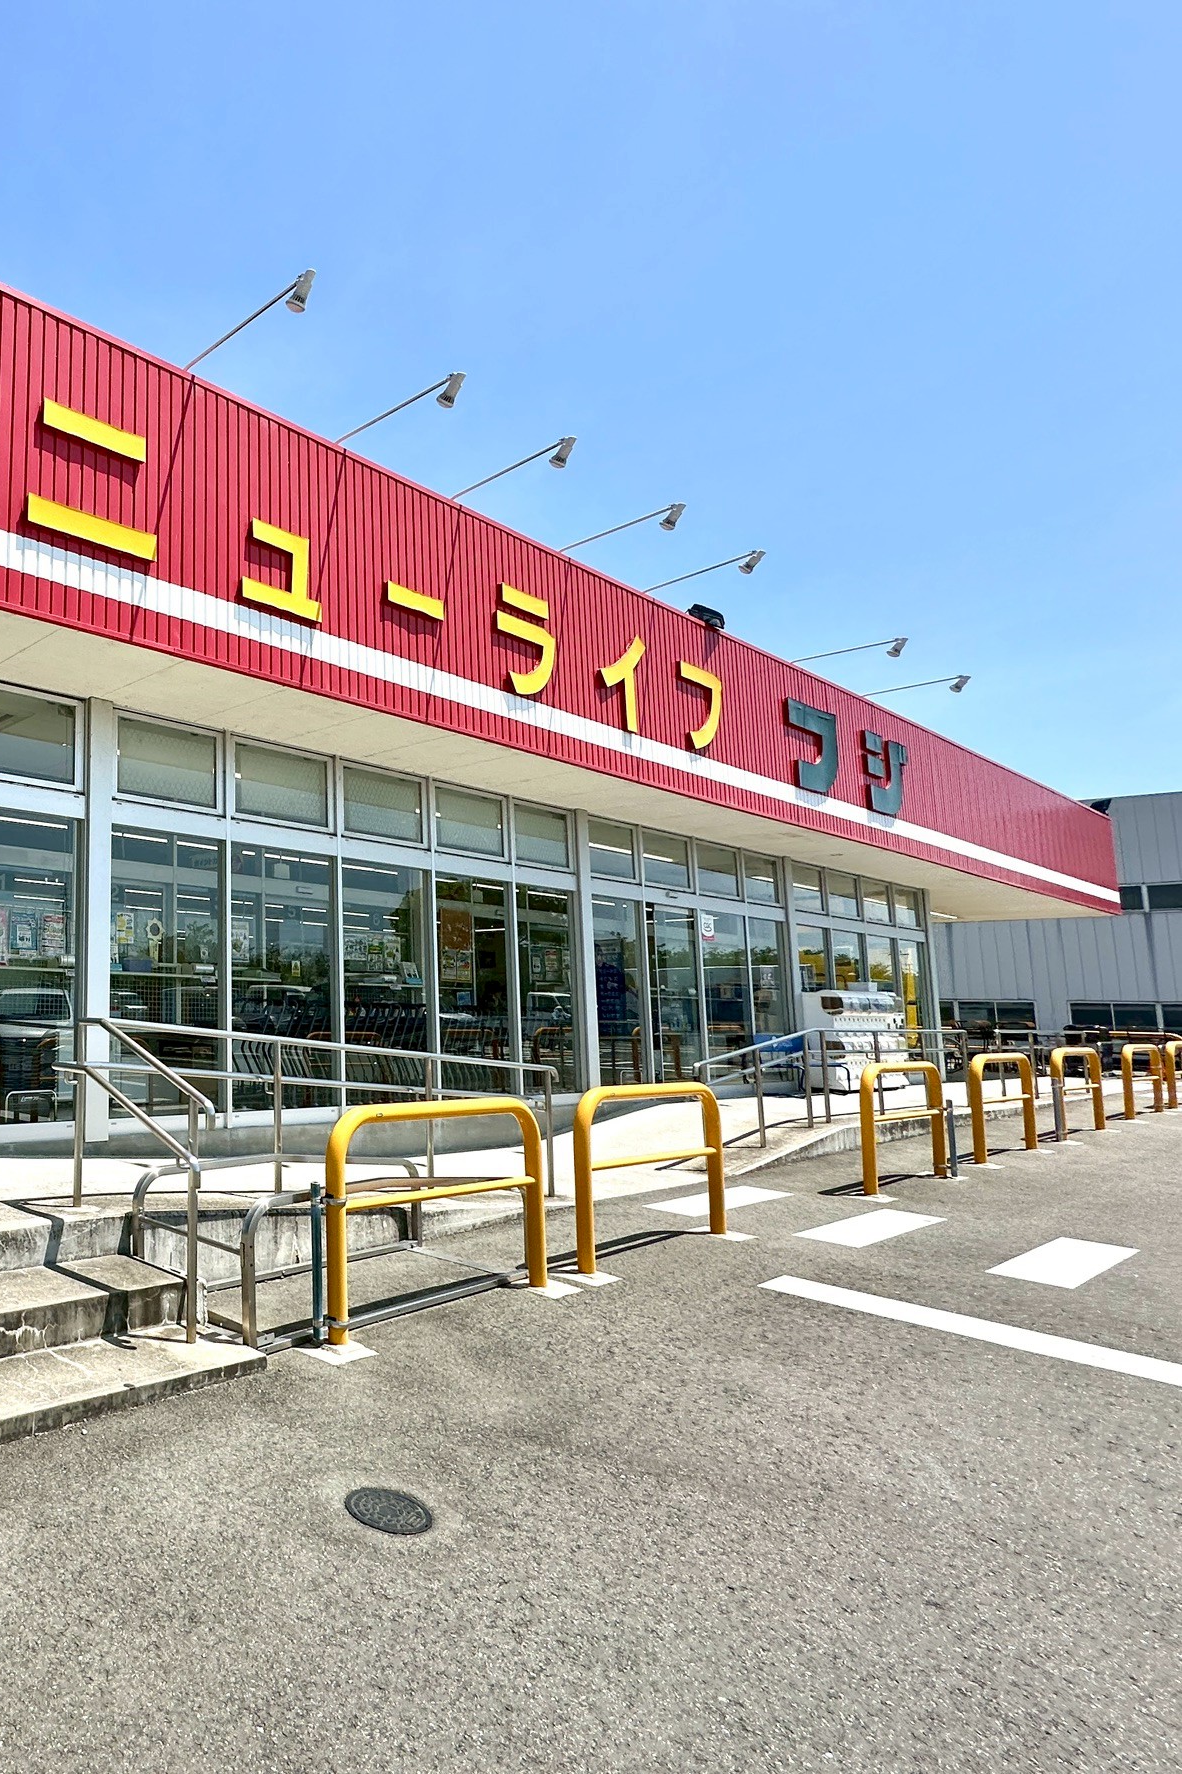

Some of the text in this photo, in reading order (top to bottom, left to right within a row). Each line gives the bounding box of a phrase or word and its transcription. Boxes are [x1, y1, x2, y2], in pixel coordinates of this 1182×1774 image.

[27, 397, 908, 815] ニューライフ フジ
